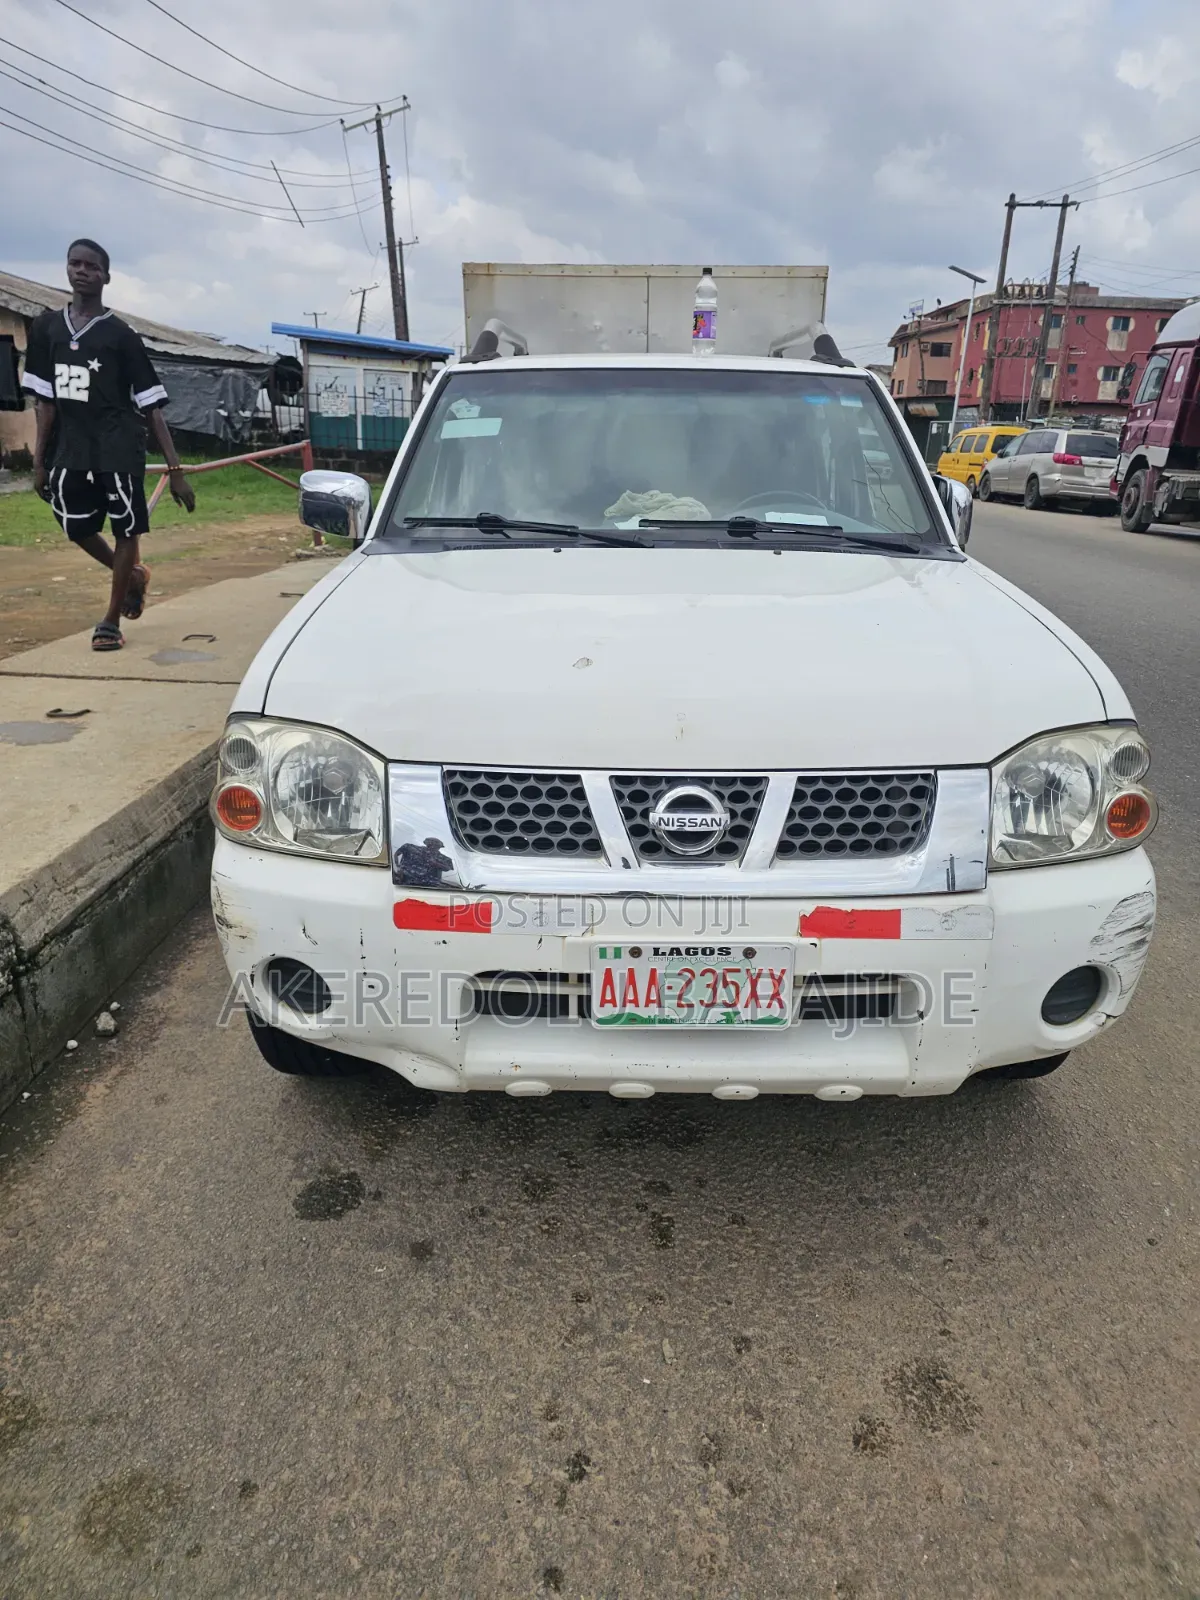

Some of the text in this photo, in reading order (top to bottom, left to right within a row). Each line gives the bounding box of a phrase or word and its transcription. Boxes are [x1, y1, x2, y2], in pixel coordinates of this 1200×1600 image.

[54, 363, 90, 402] 22
[658, 816, 722, 828] NISSAN
[653, 946, 732, 957] LAGOS
